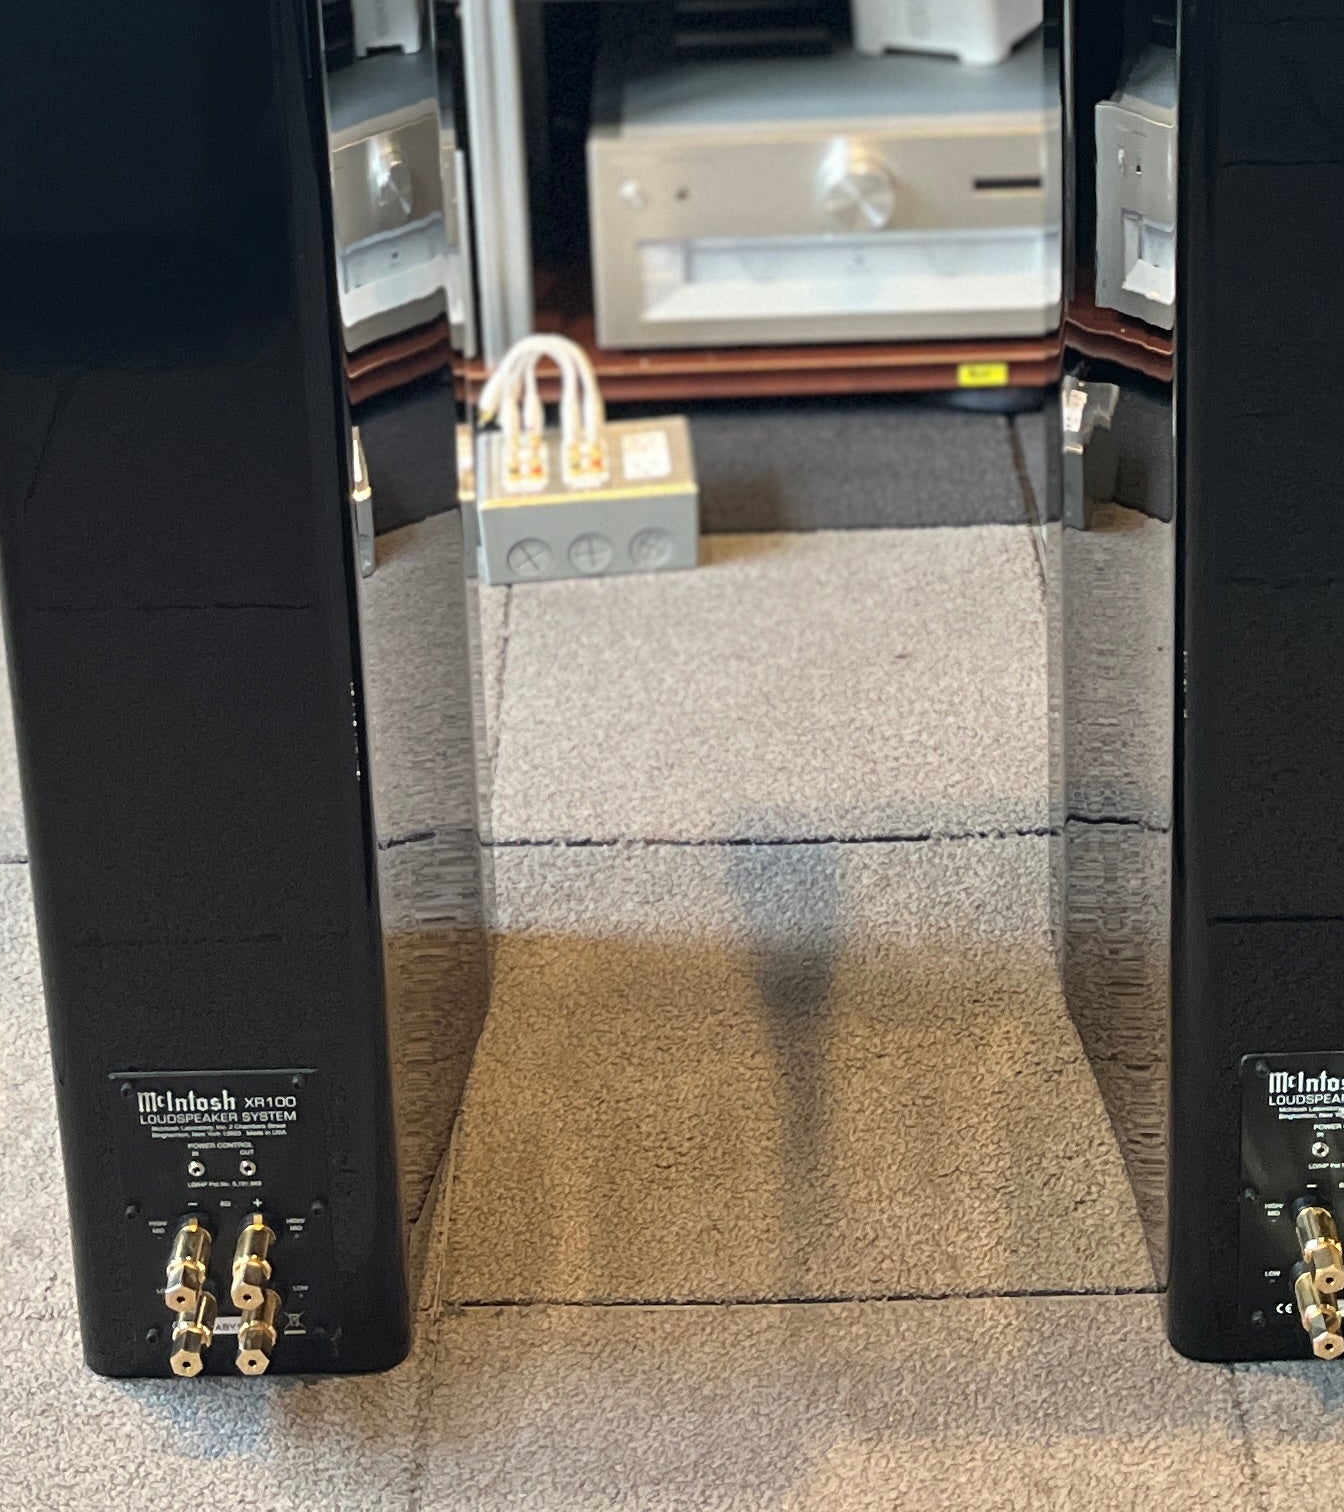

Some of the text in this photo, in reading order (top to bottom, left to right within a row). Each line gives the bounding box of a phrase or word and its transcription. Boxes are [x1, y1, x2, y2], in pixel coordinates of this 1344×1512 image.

[137, 1089, 297, 1113] McIntosh XR100
[140, 1110, 297, 1125] LOUDSPEAKER SYSTEM
